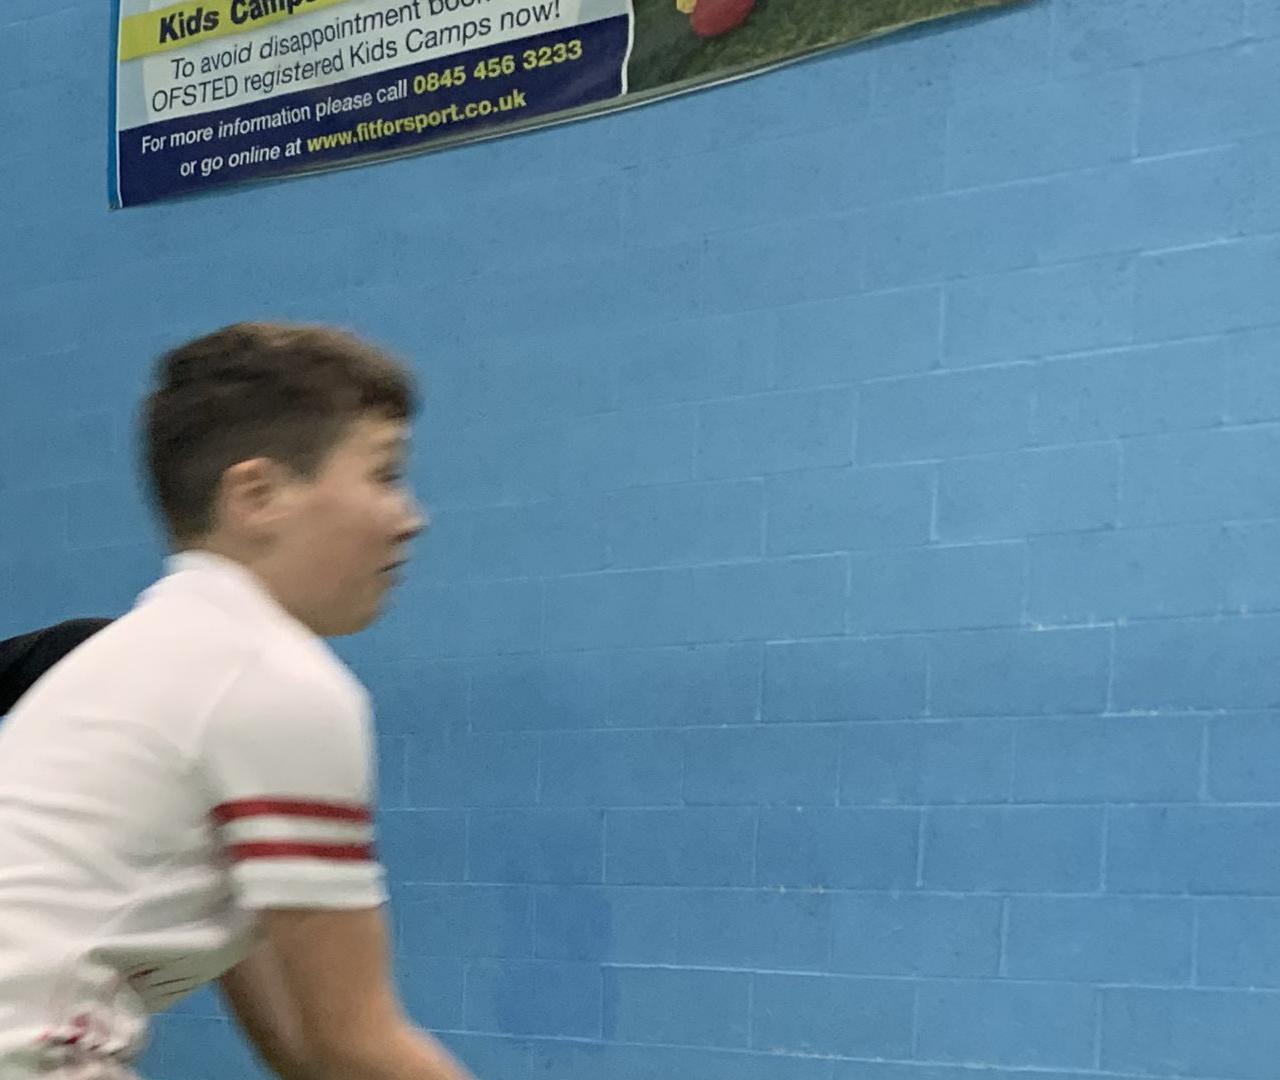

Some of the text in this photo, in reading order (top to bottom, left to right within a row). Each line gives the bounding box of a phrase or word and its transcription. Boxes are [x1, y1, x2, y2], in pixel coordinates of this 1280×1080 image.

[151, 0, 560, 112] OFSTED registered Kids Camps now!
[159, 0, 318, 44] Kids Camp
[171, 57, 195, 80] To
[200, 41, 253, 74] avoid
[259, 2, 421, 60] disappointment
[141, 39, 583, 154] For more information please call 0845 456 3233
[180, 88, 528, 177] or go online at www.fitforsport.co.uk
